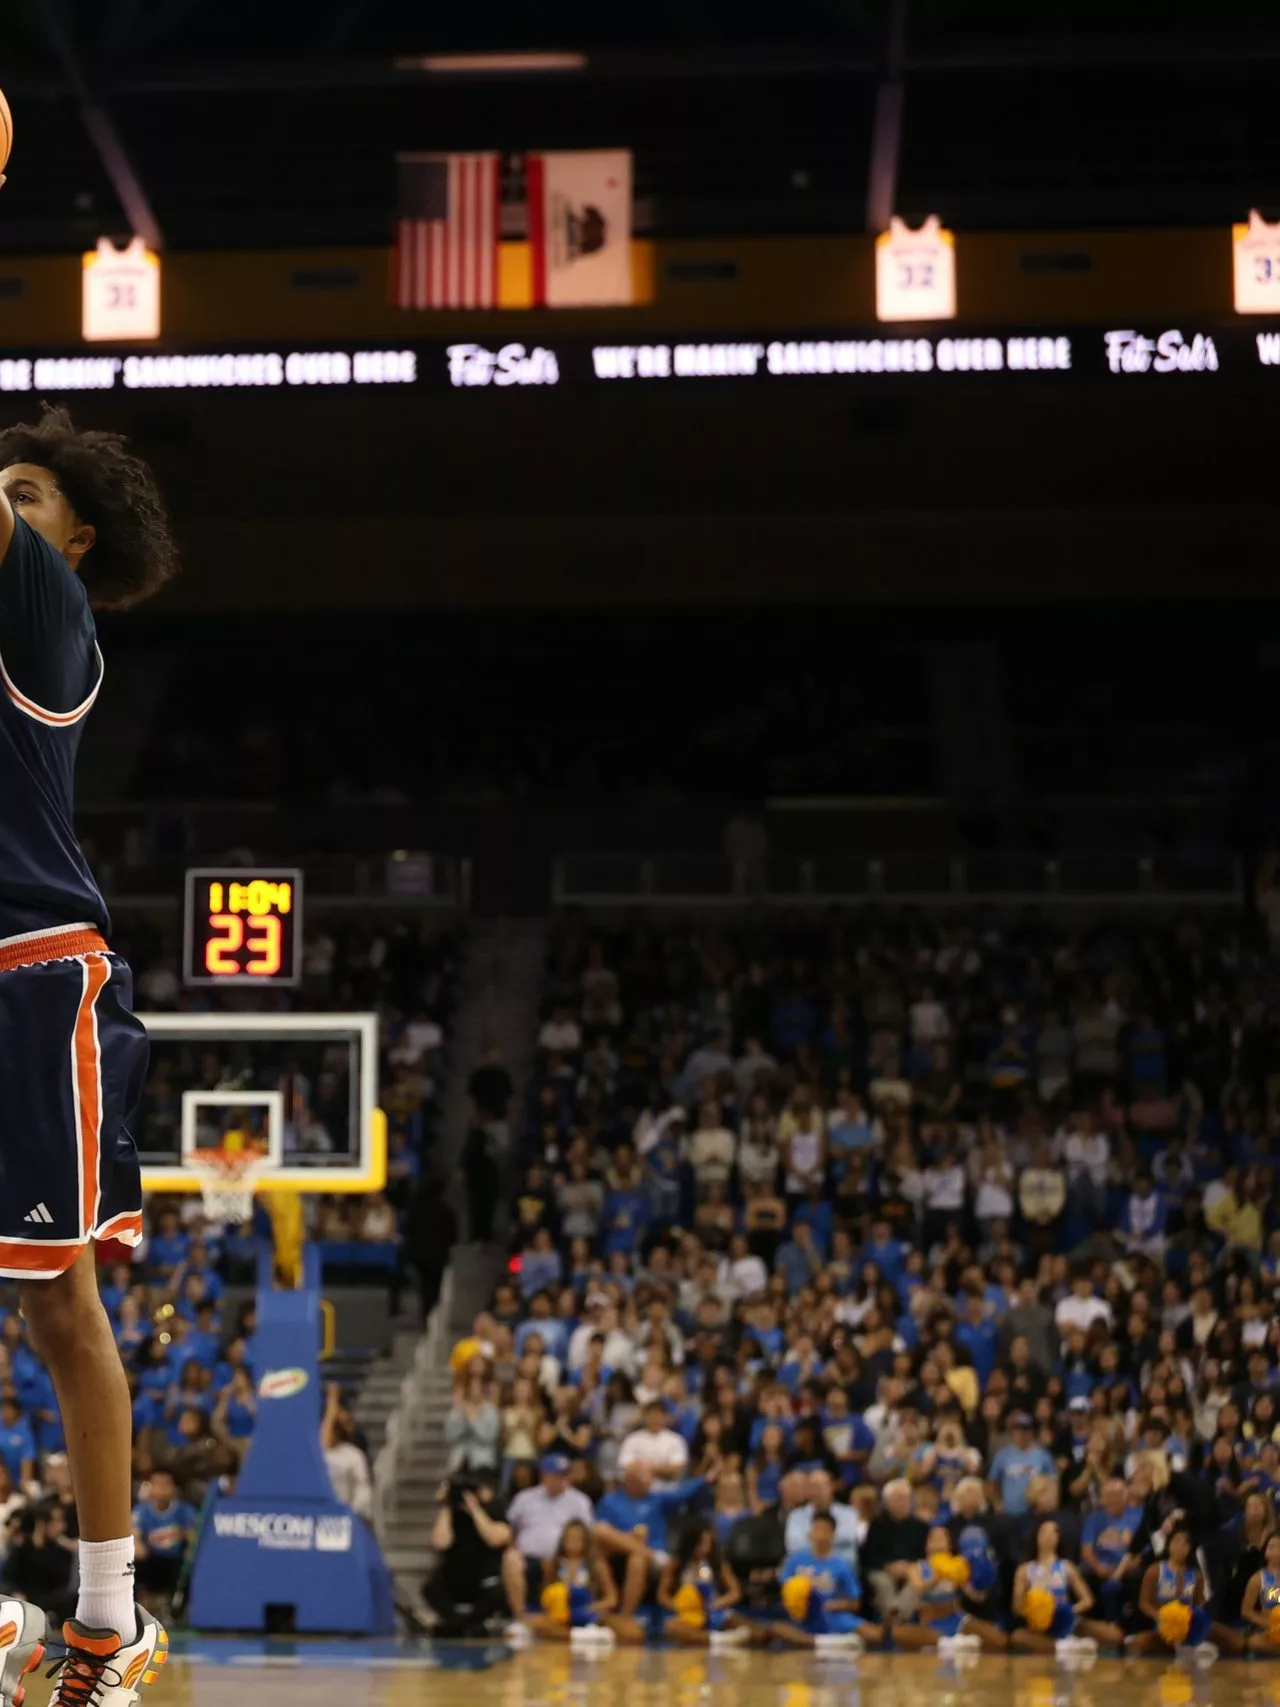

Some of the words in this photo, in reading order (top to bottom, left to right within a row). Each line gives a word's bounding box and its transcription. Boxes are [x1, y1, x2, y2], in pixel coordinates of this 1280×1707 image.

[1254, 255, 1280, 284] 3
[209, 880, 291, 915] 11:04
[205, 914, 281, 975] 23
[213, 1512, 314, 1539] WESCOM
